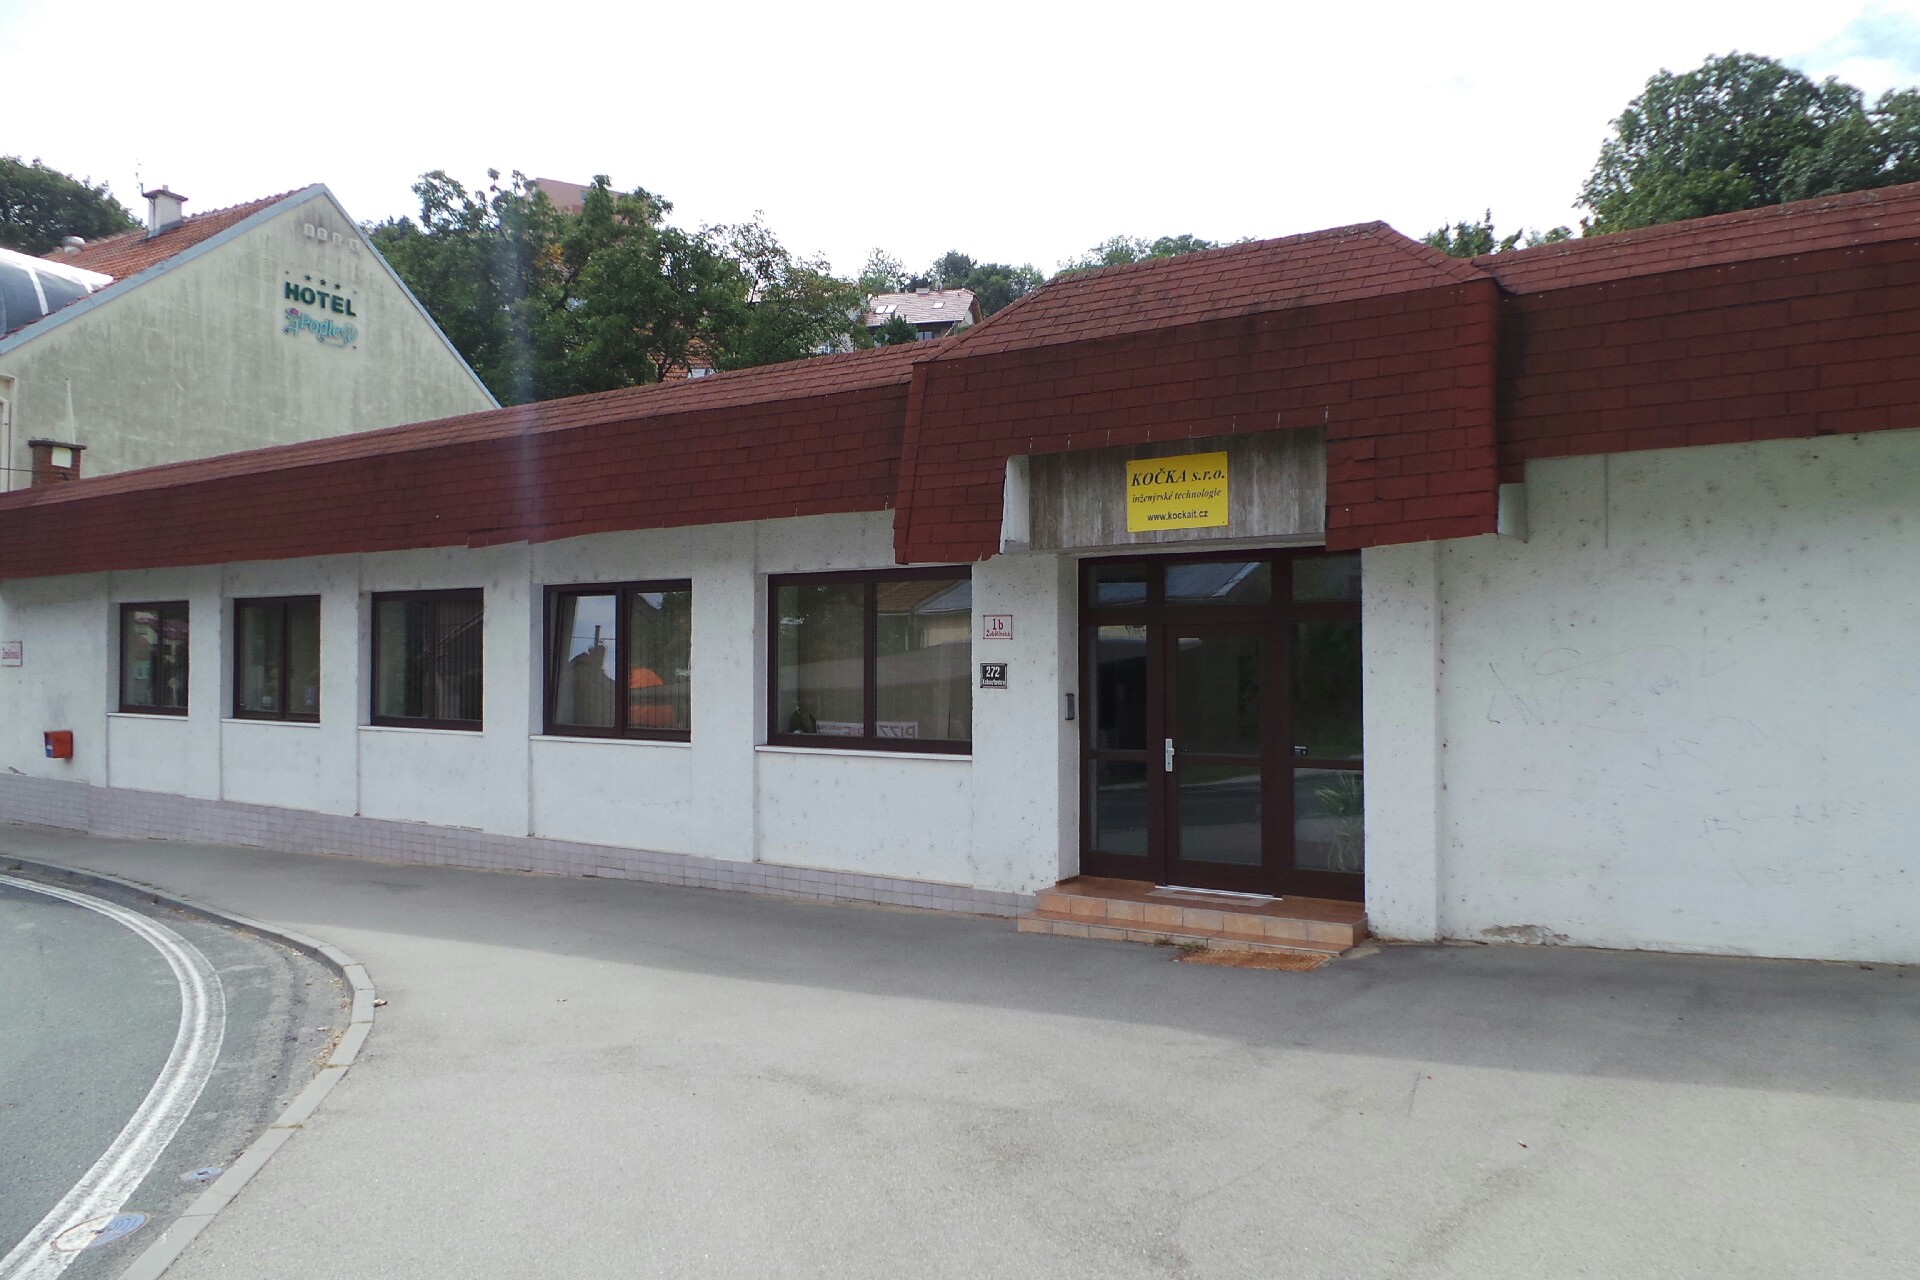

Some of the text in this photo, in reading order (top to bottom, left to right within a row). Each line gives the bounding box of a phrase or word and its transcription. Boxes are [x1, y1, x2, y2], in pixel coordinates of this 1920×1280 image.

[284, 281, 357, 317] HOTEL
[1131, 467, 1225, 486] KOČKA s.r.o.
[1132, 488, 1222, 504] inženýrské technologie
[1147, 510, 1208, 521] www.kockait.cz
[992, 618, 1004, 630] 1b
[985, 666, 1000, 677] 272
